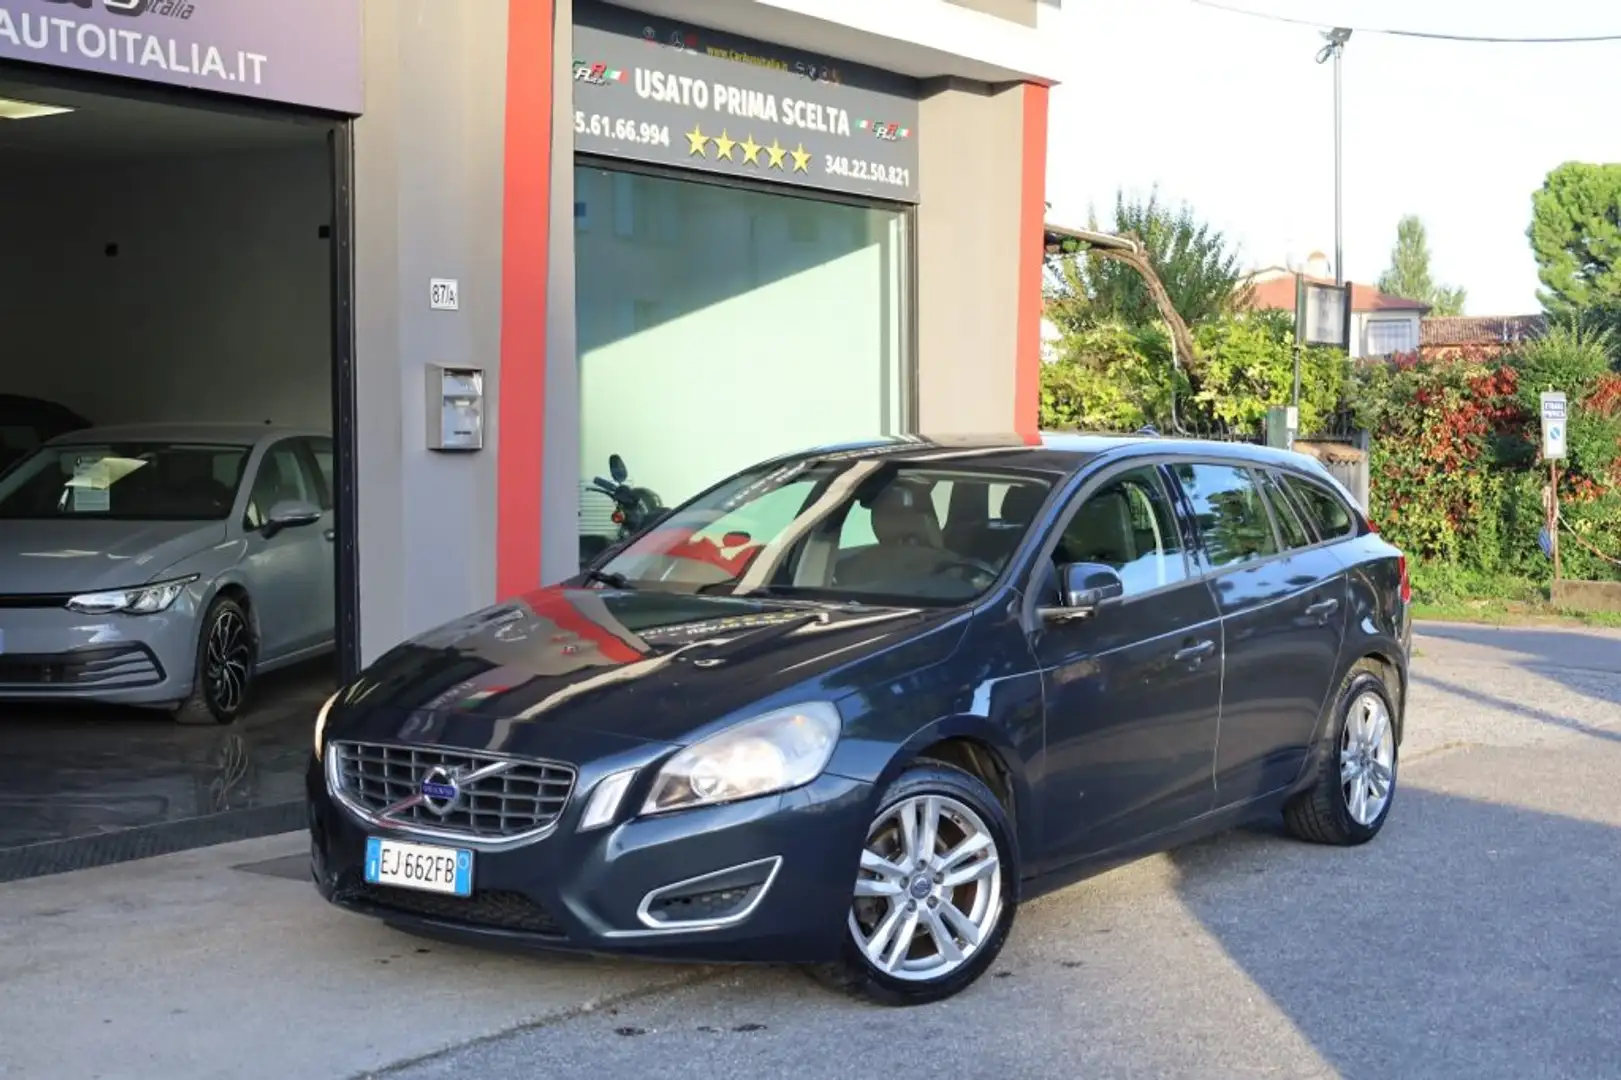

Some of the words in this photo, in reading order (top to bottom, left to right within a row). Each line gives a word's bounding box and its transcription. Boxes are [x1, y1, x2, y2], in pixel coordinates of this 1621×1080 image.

[634, 68, 709, 109] USATO
[714, 84, 778, 123] PRIMA
[782, 98, 850, 137] SCELTA
[825, 154, 909, 187] 348.22.50.821
[432, 284, 456, 305] 87/A
